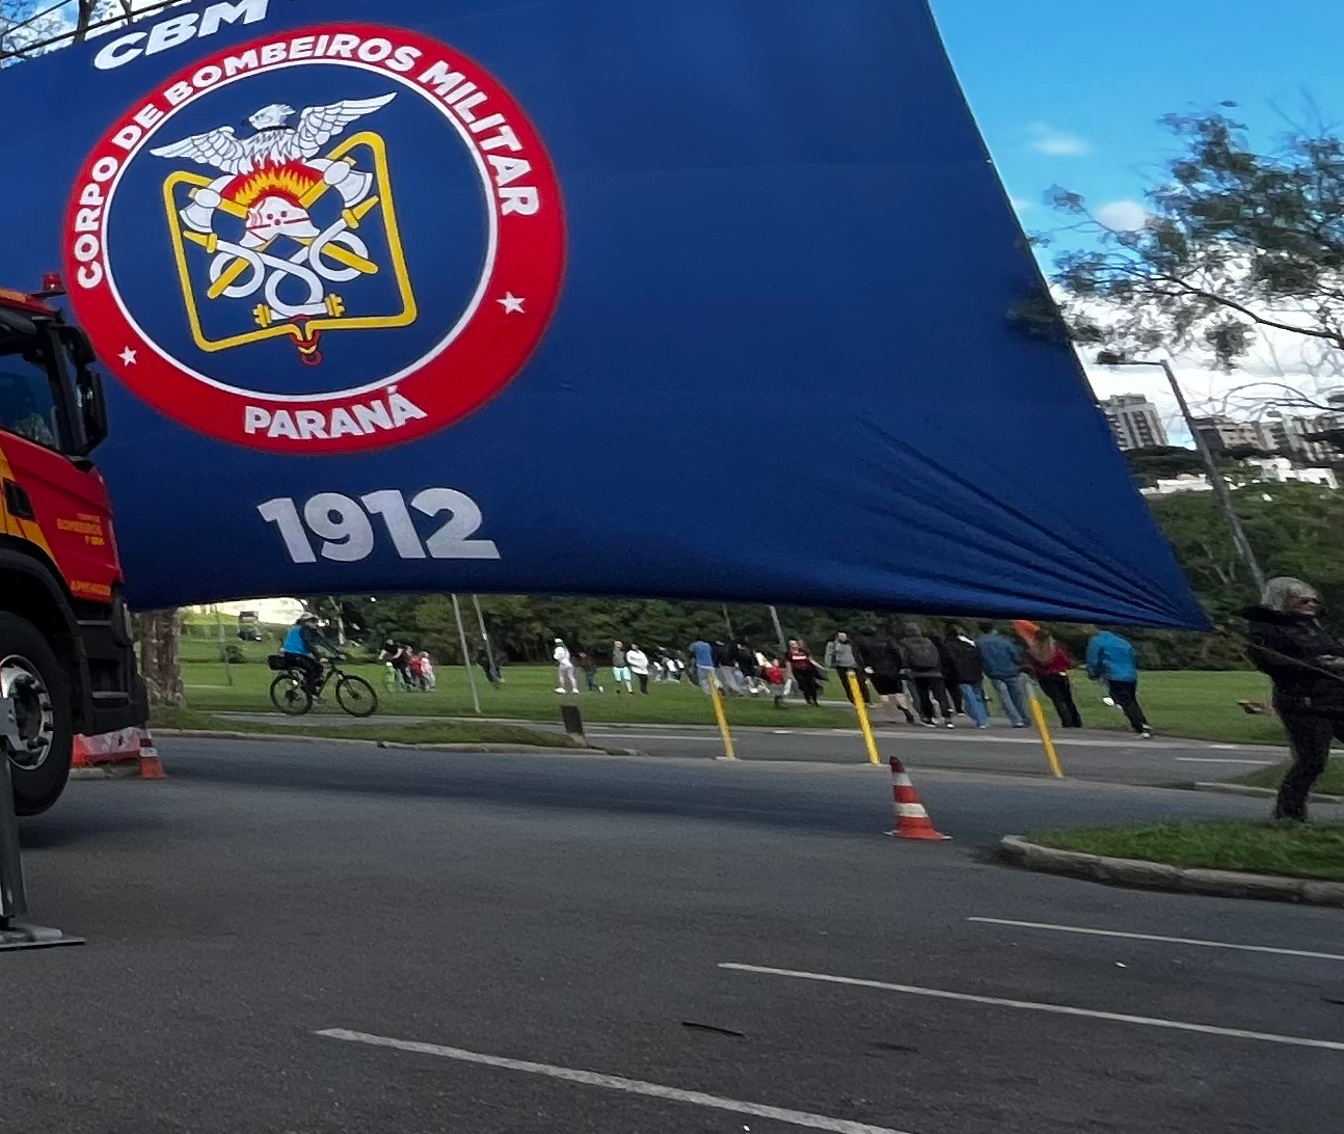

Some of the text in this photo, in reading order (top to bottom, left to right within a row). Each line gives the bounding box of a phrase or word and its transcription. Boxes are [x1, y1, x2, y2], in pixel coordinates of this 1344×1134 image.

[74, 33, 540, 289] CORPO DE BOMBEIROS MILITAR
[245, 385, 428, 440] PARANÁ
[257, 487, 500, 563] 1912
